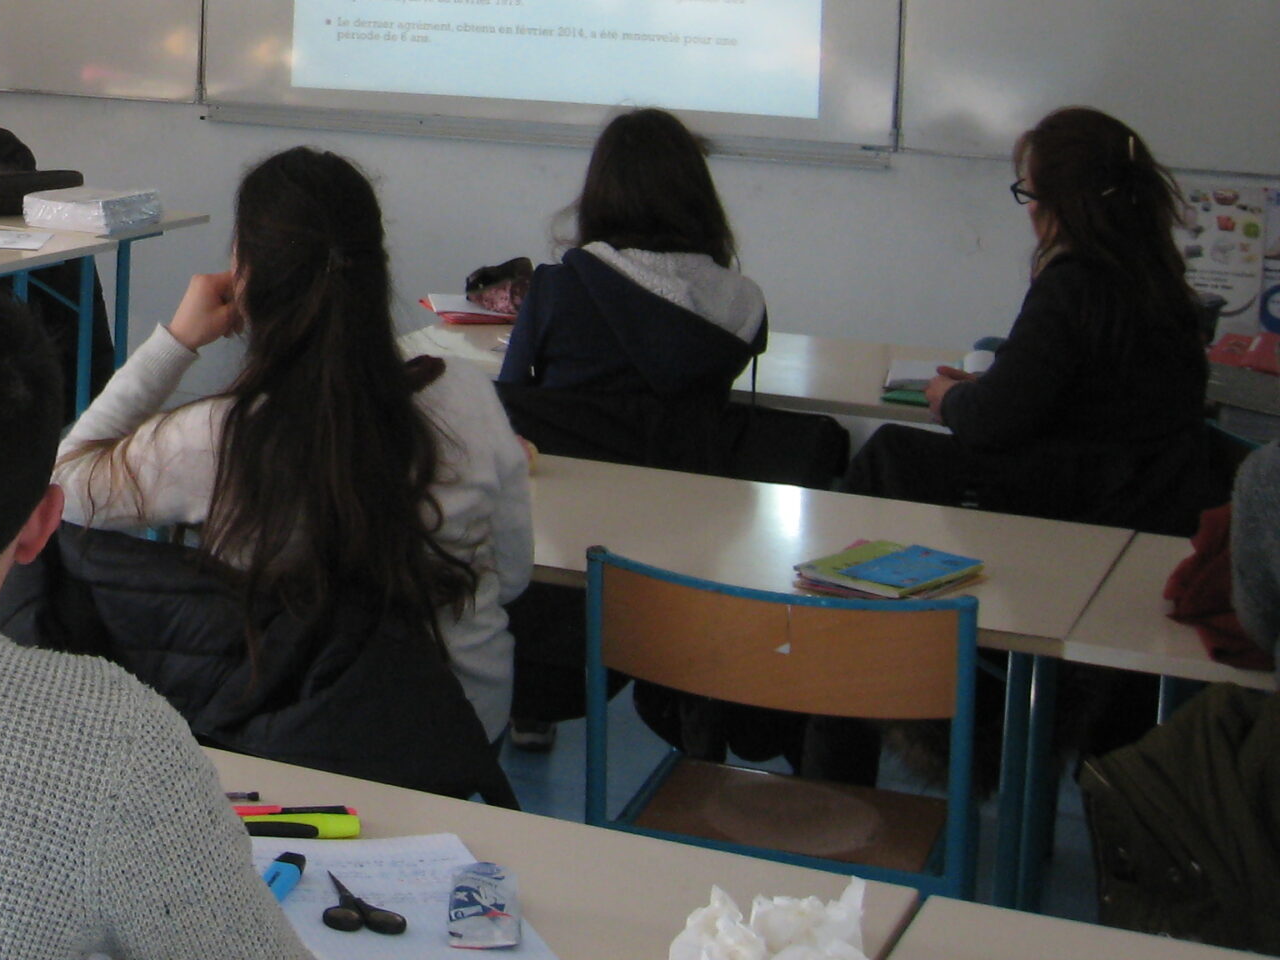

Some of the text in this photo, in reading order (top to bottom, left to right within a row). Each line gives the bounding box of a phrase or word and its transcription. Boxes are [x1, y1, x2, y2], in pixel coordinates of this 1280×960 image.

[337, 16, 350, 27] Le
[456, 23, 496, 34] obtenu
[684, 35, 713, 47] pour
[384, 31, 398, 42] de
